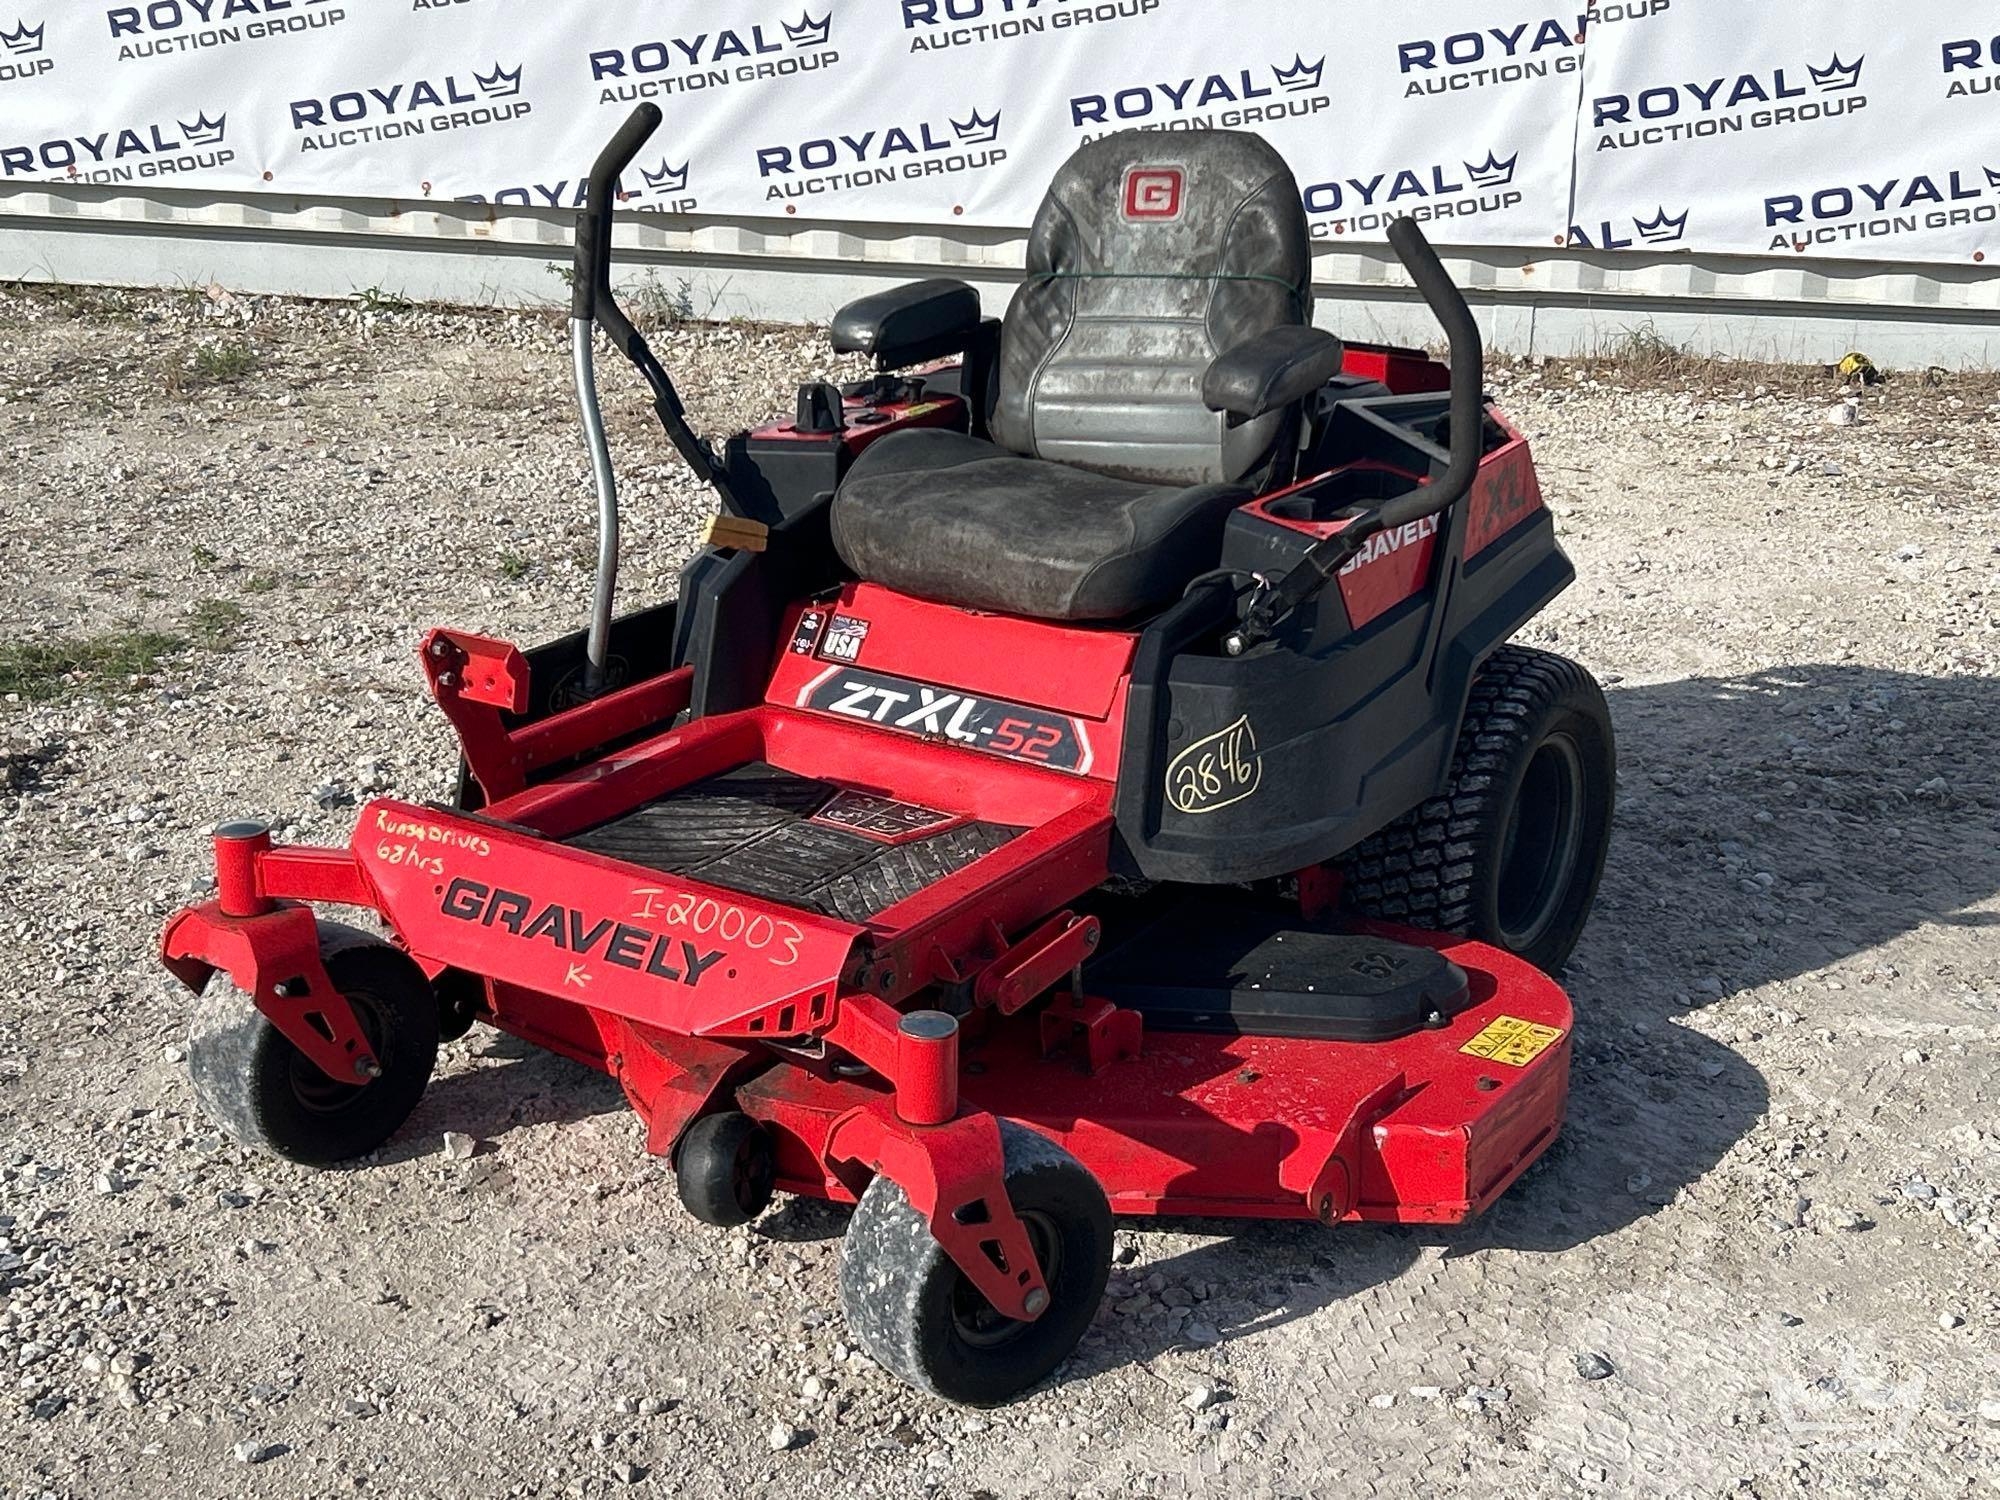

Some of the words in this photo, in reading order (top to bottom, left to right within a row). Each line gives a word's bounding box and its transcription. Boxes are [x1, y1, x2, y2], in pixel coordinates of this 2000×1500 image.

[118, 26, 240, 61] AUCTION
[246, 9, 346, 40] GROUP
[589, 25, 782, 81] ROYAL
[910, 16, 1044, 53] AUCTION
[1051, 0, 1160, 29] GROUP
[290, 76, 476, 129] ROYAL
[599, 69, 728, 104] AUCTION
[736, 50, 839, 81] GROUP
[1070, 69, 1272, 127] ROYAL
[1403, 60, 1547, 98] AUCTION
[1593, 69, 1806, 128] ROYAL
[301, 118, 424, 152] AUCTION
[431, 101, 532, 131] GROUP
[1220, 96, 1330, 127] GROUP
[1596, 115, 1743, 152] AUCTION
[1750, 95, 1867, 128] GROUP
[0, 125, 181, 176] ROYAL
[139, 150, 235, 178] GROUP
[756, 122, 951, 177] ROYAL
[766, 166, 896, 201] AUCTION
[903, 149, 1008, 179] GROUP
[1303, 164, 1464, 213] OYAL
[1411, 191, 1522, 222] GROUP
[1764, 170, 1982, 227] ROYAL
[1769, 215, 1917, 250] AUCTION
[1925, 204, 2000, 229] GRO
[1482, 463, 1526, 531] XL
[823, 632, 861, 659] USA
[1176, 727, 1252, 810] 2846
[441, 877, 727, 987] GRAVELY
